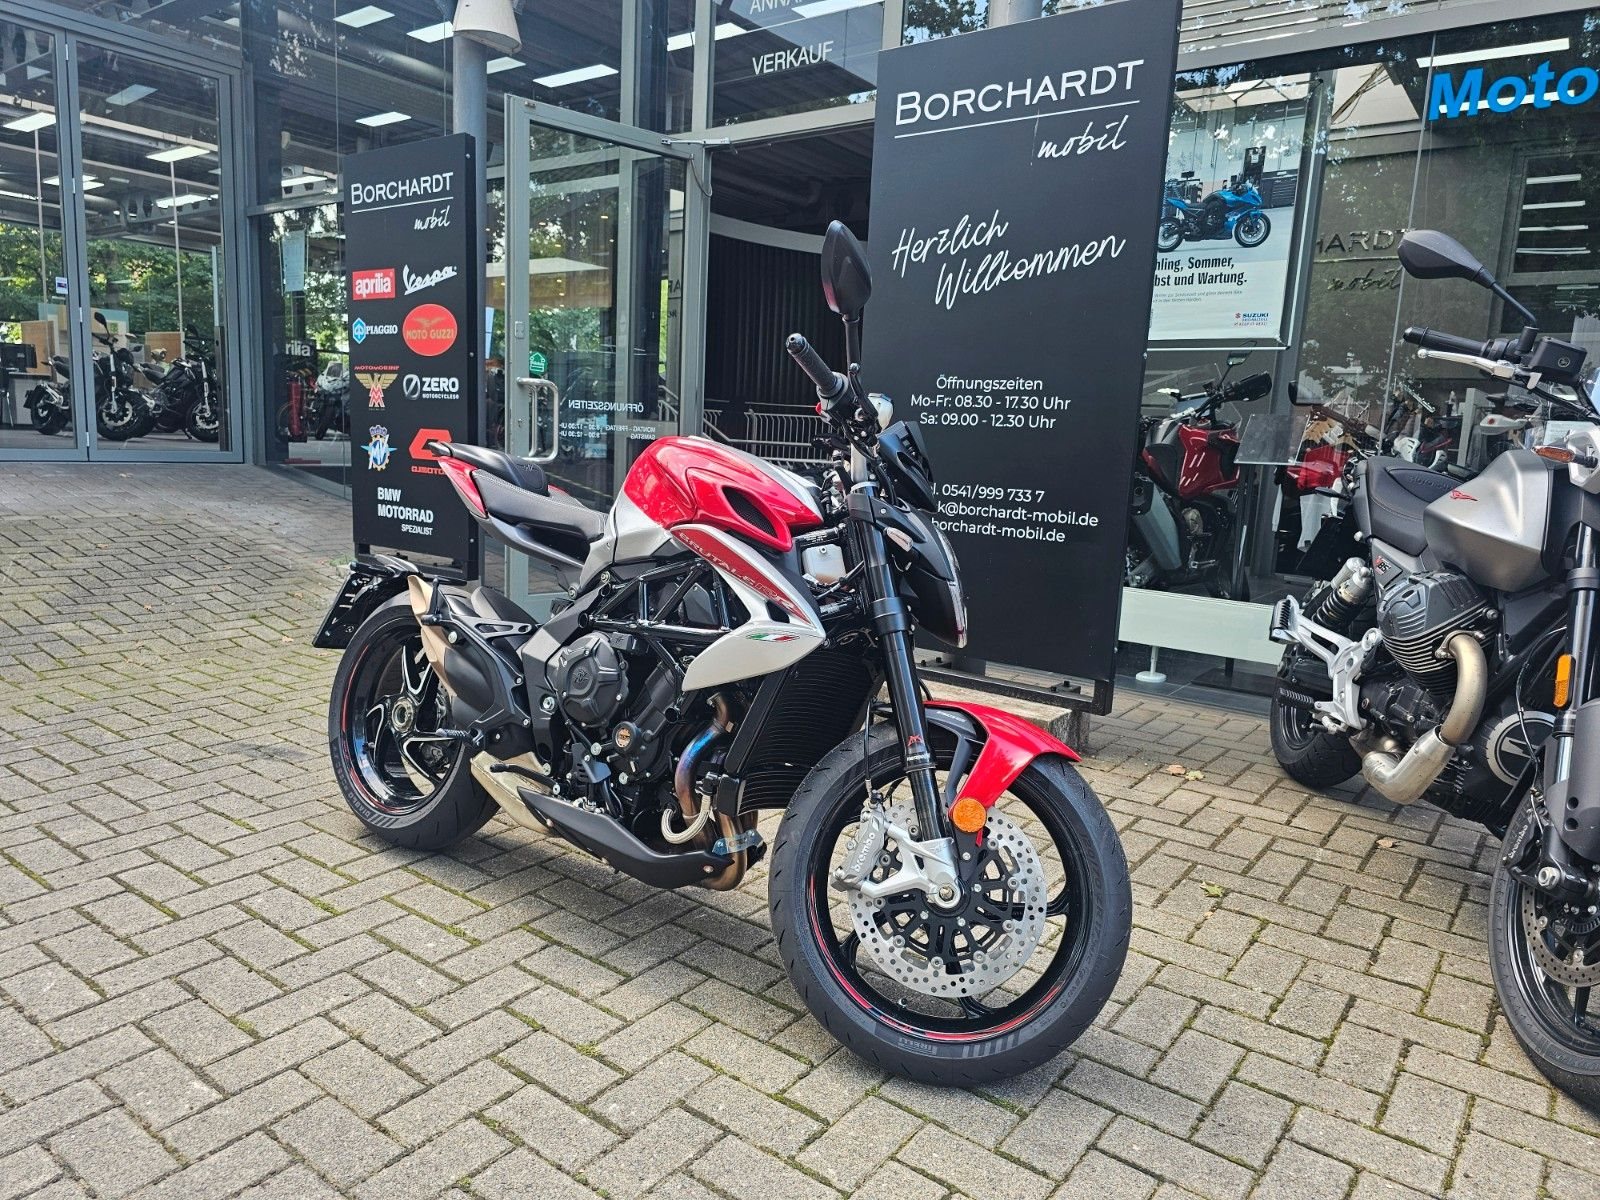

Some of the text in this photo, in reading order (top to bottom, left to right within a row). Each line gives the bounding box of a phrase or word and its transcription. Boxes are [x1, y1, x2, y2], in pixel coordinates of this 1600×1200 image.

[752, 40, 834, 76] VERKAUF
[895, 59, 1144, 126] BORCHARDT
[1428, 59, 1600, 121] Moto
[1037, 114, 1129, 159] mobil
[351, 172, 454, 205] BORCHARDT
[414, 205, 451, 230] mobil
[891, 209, 1009, 278] Herzlich
[934, 235, 1127, 310] Willkommen
[1187, 257, 1235, 269] Sommer,
[355, 272, 392, 298] aprilia
[402, 264, 457, 296] Vespa
[1174, 272, 1195, 286] und
[1198, 271, 1248, 286] Wartung.
[366, 324, 398, 335] PIAGGIO
[406, 329, 454, 340] MOTO GUZZI
[422, 377, 459, 392] ZERO
[936, 374, 1043, 393] Öffnungszeiten
[910, 394, 952, 407] Mo-Fr:
[954, 395, 993, 408] 08.30
[1004, 396, 1039, 410] 17.30
[1042, 396, 1071, 411] Uhr
[920, 412, 938, 425] Sa:
[941, 413, 978, 426] 09.00
[990, 414, 1025, 427] 12.30
[1028, 415, 1057, 429] Uhr
[377, 486, 401, 502] BMW
[942, 483, 1004, 501] 0541/999
[1007, 488, 1032, 503] 733
[1035, 490, 1045, 504] 7
[377, 503, 433, 524] MOTORRAD
[401, 523, 433, 536] SPEZIALIST
[850, 832, 876, 872] brembo
